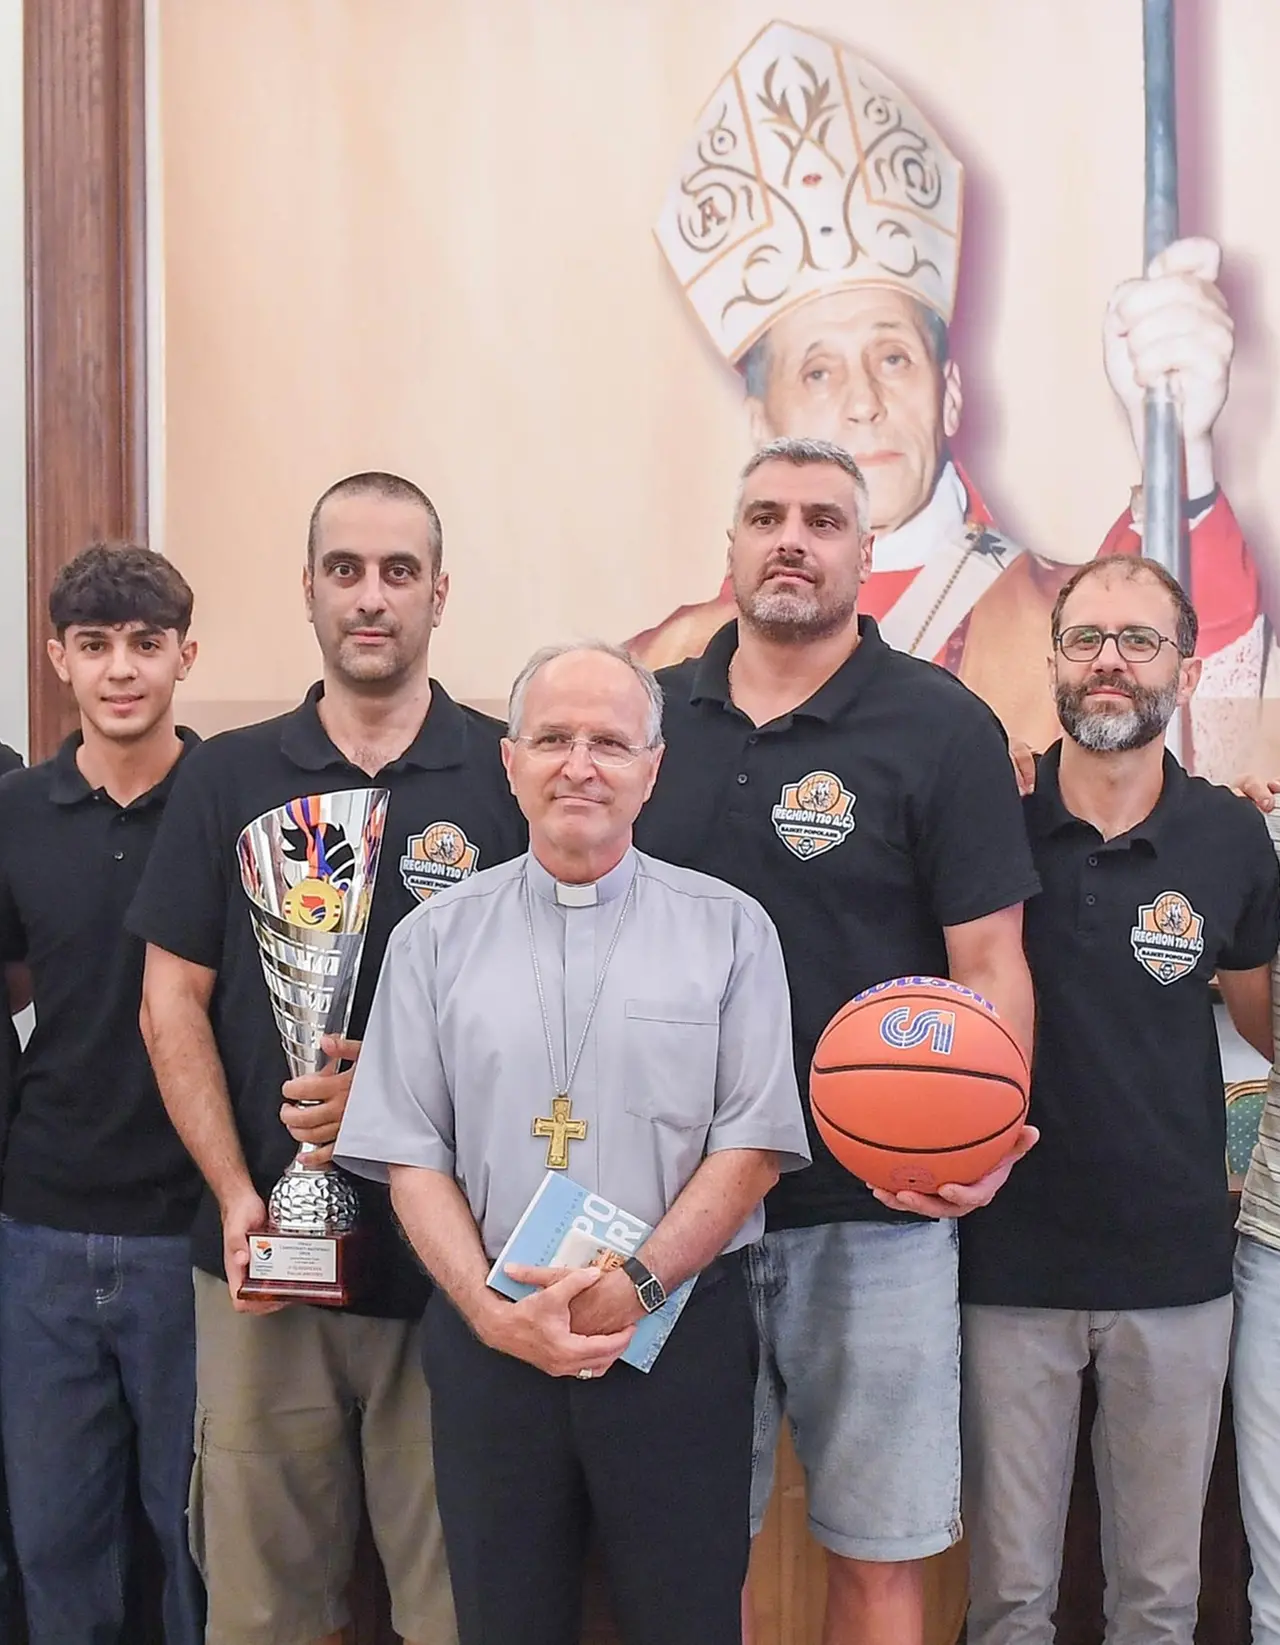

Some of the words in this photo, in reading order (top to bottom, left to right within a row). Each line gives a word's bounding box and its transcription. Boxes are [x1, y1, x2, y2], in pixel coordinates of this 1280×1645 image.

[774, 808, 816, 823] REGHION
[402, 859, 445, 876] REGHION
[1134, 930, 1175, 947] REGHION
